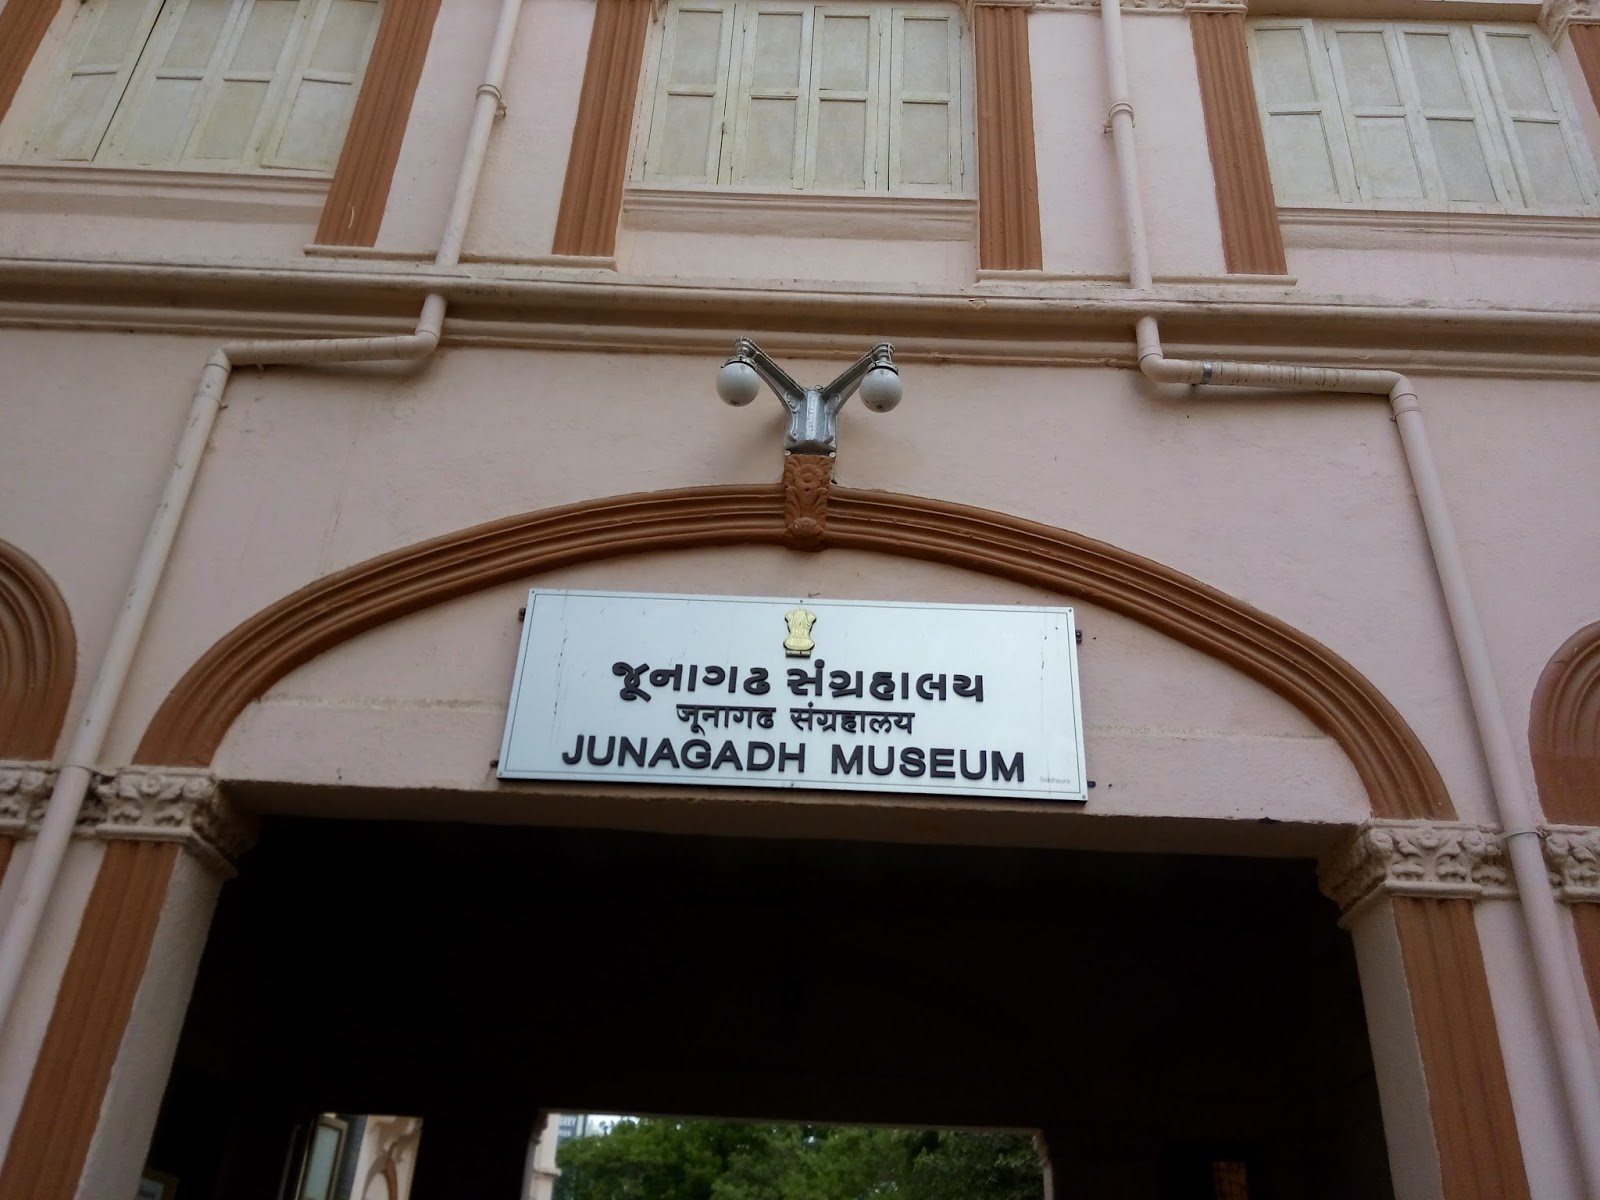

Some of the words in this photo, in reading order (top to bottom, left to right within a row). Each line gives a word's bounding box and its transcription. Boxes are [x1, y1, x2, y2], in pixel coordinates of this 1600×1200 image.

[611, 661, 771, 703] જૂનાગઢ
[786, 658, 984, 703] સંગ્રહાલય
[676, 703, 777, 736] जूनागढ
[789, 701, 916, 735] संग्रहालय
[562, 734, 806, 774] JUNAGADH
[830, 743, 1025, 783] MUSEUM
